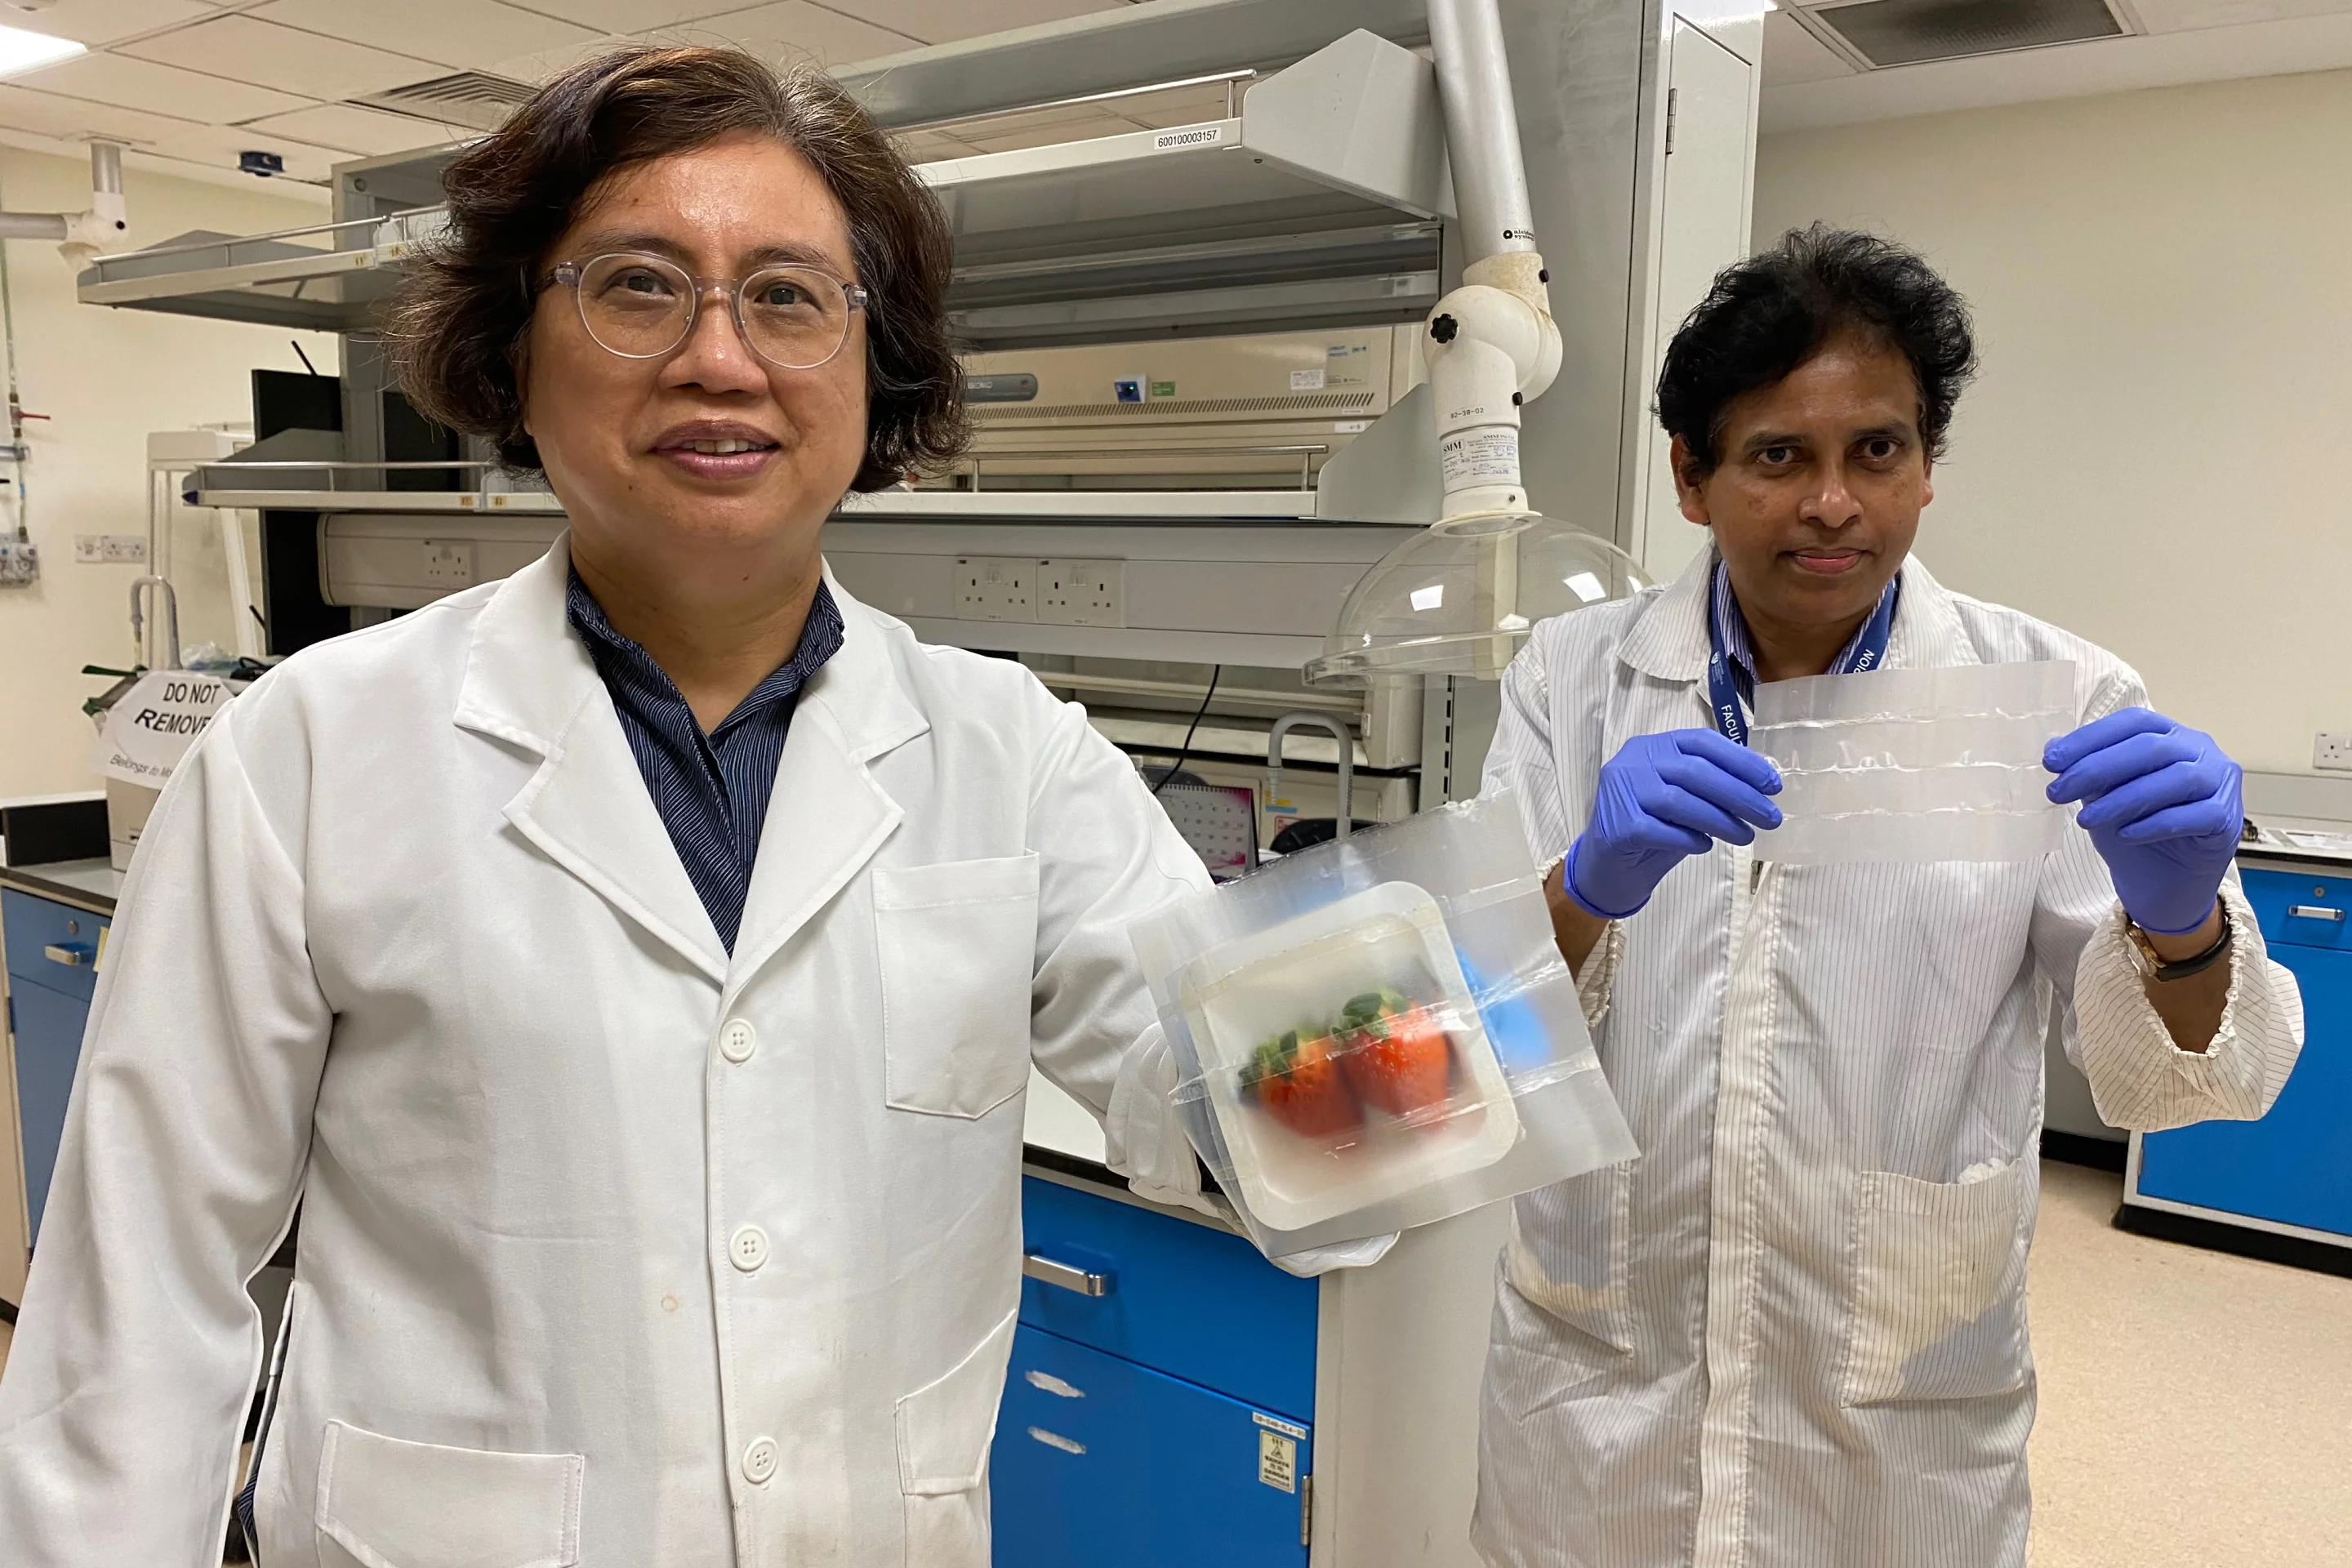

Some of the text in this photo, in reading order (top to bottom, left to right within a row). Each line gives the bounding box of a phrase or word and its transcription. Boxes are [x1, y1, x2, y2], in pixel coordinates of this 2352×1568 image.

[1158, 130, 1217, 147] 600100003157
[1443, 441, 1462, 454] SMM
[163, 683, 221, 704] DO NOT
